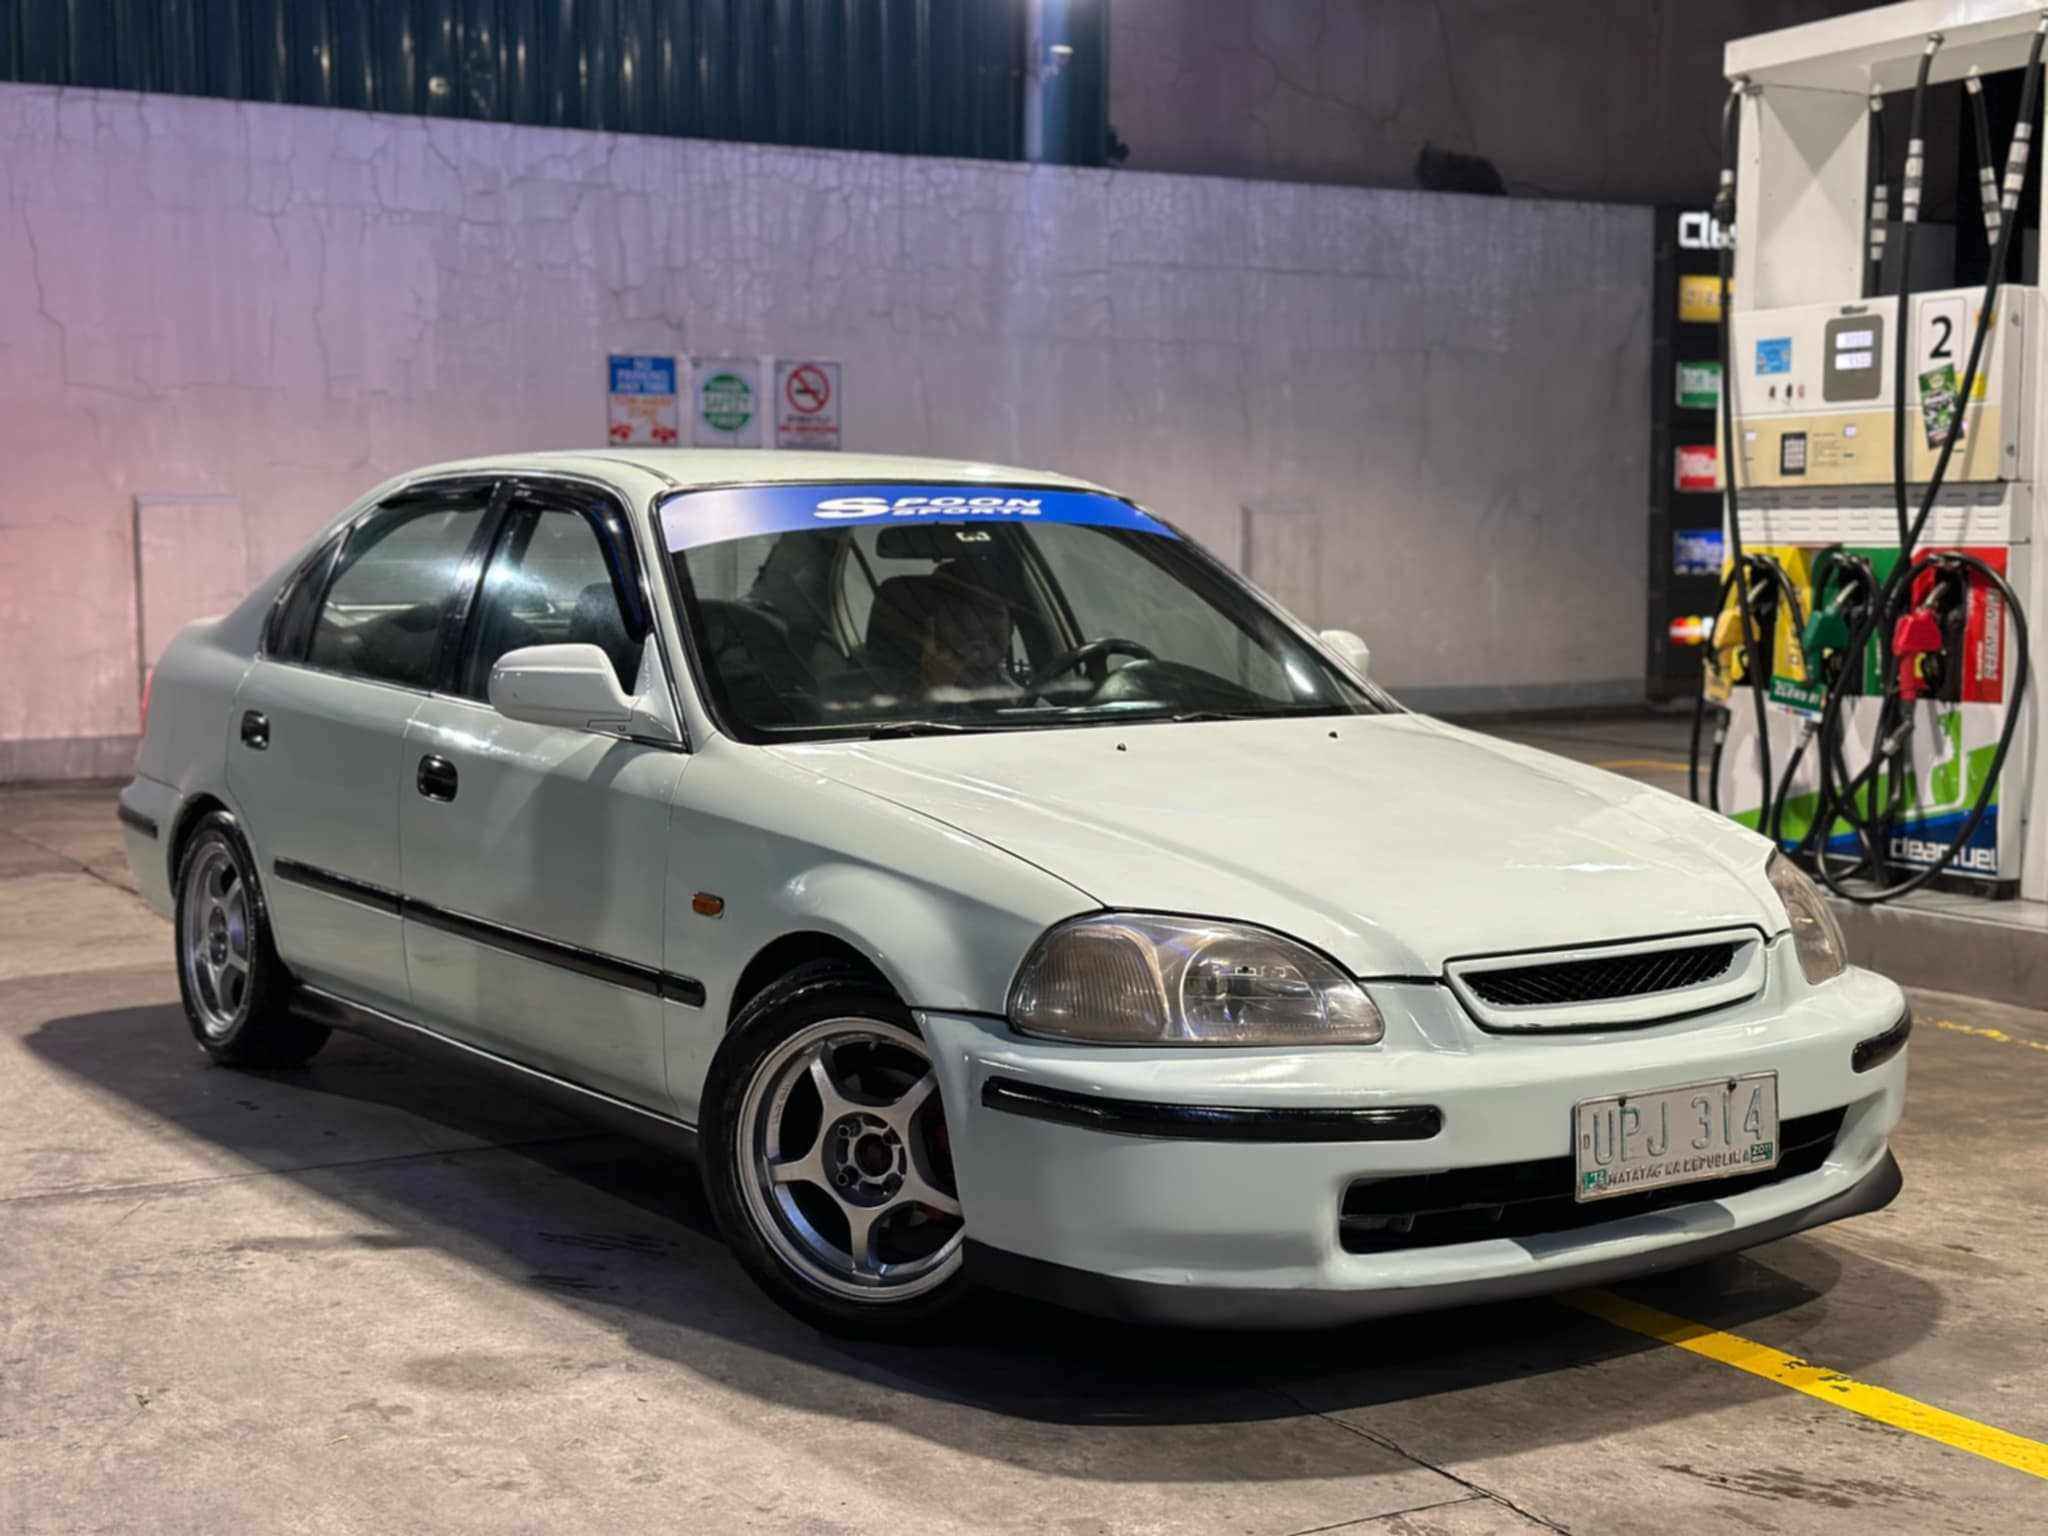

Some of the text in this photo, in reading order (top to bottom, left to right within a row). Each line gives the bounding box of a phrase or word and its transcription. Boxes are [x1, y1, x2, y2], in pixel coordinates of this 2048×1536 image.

[1930, 315, 1952, 358] 2
[1593, 1085, 1764, 1166] UPJ 314
